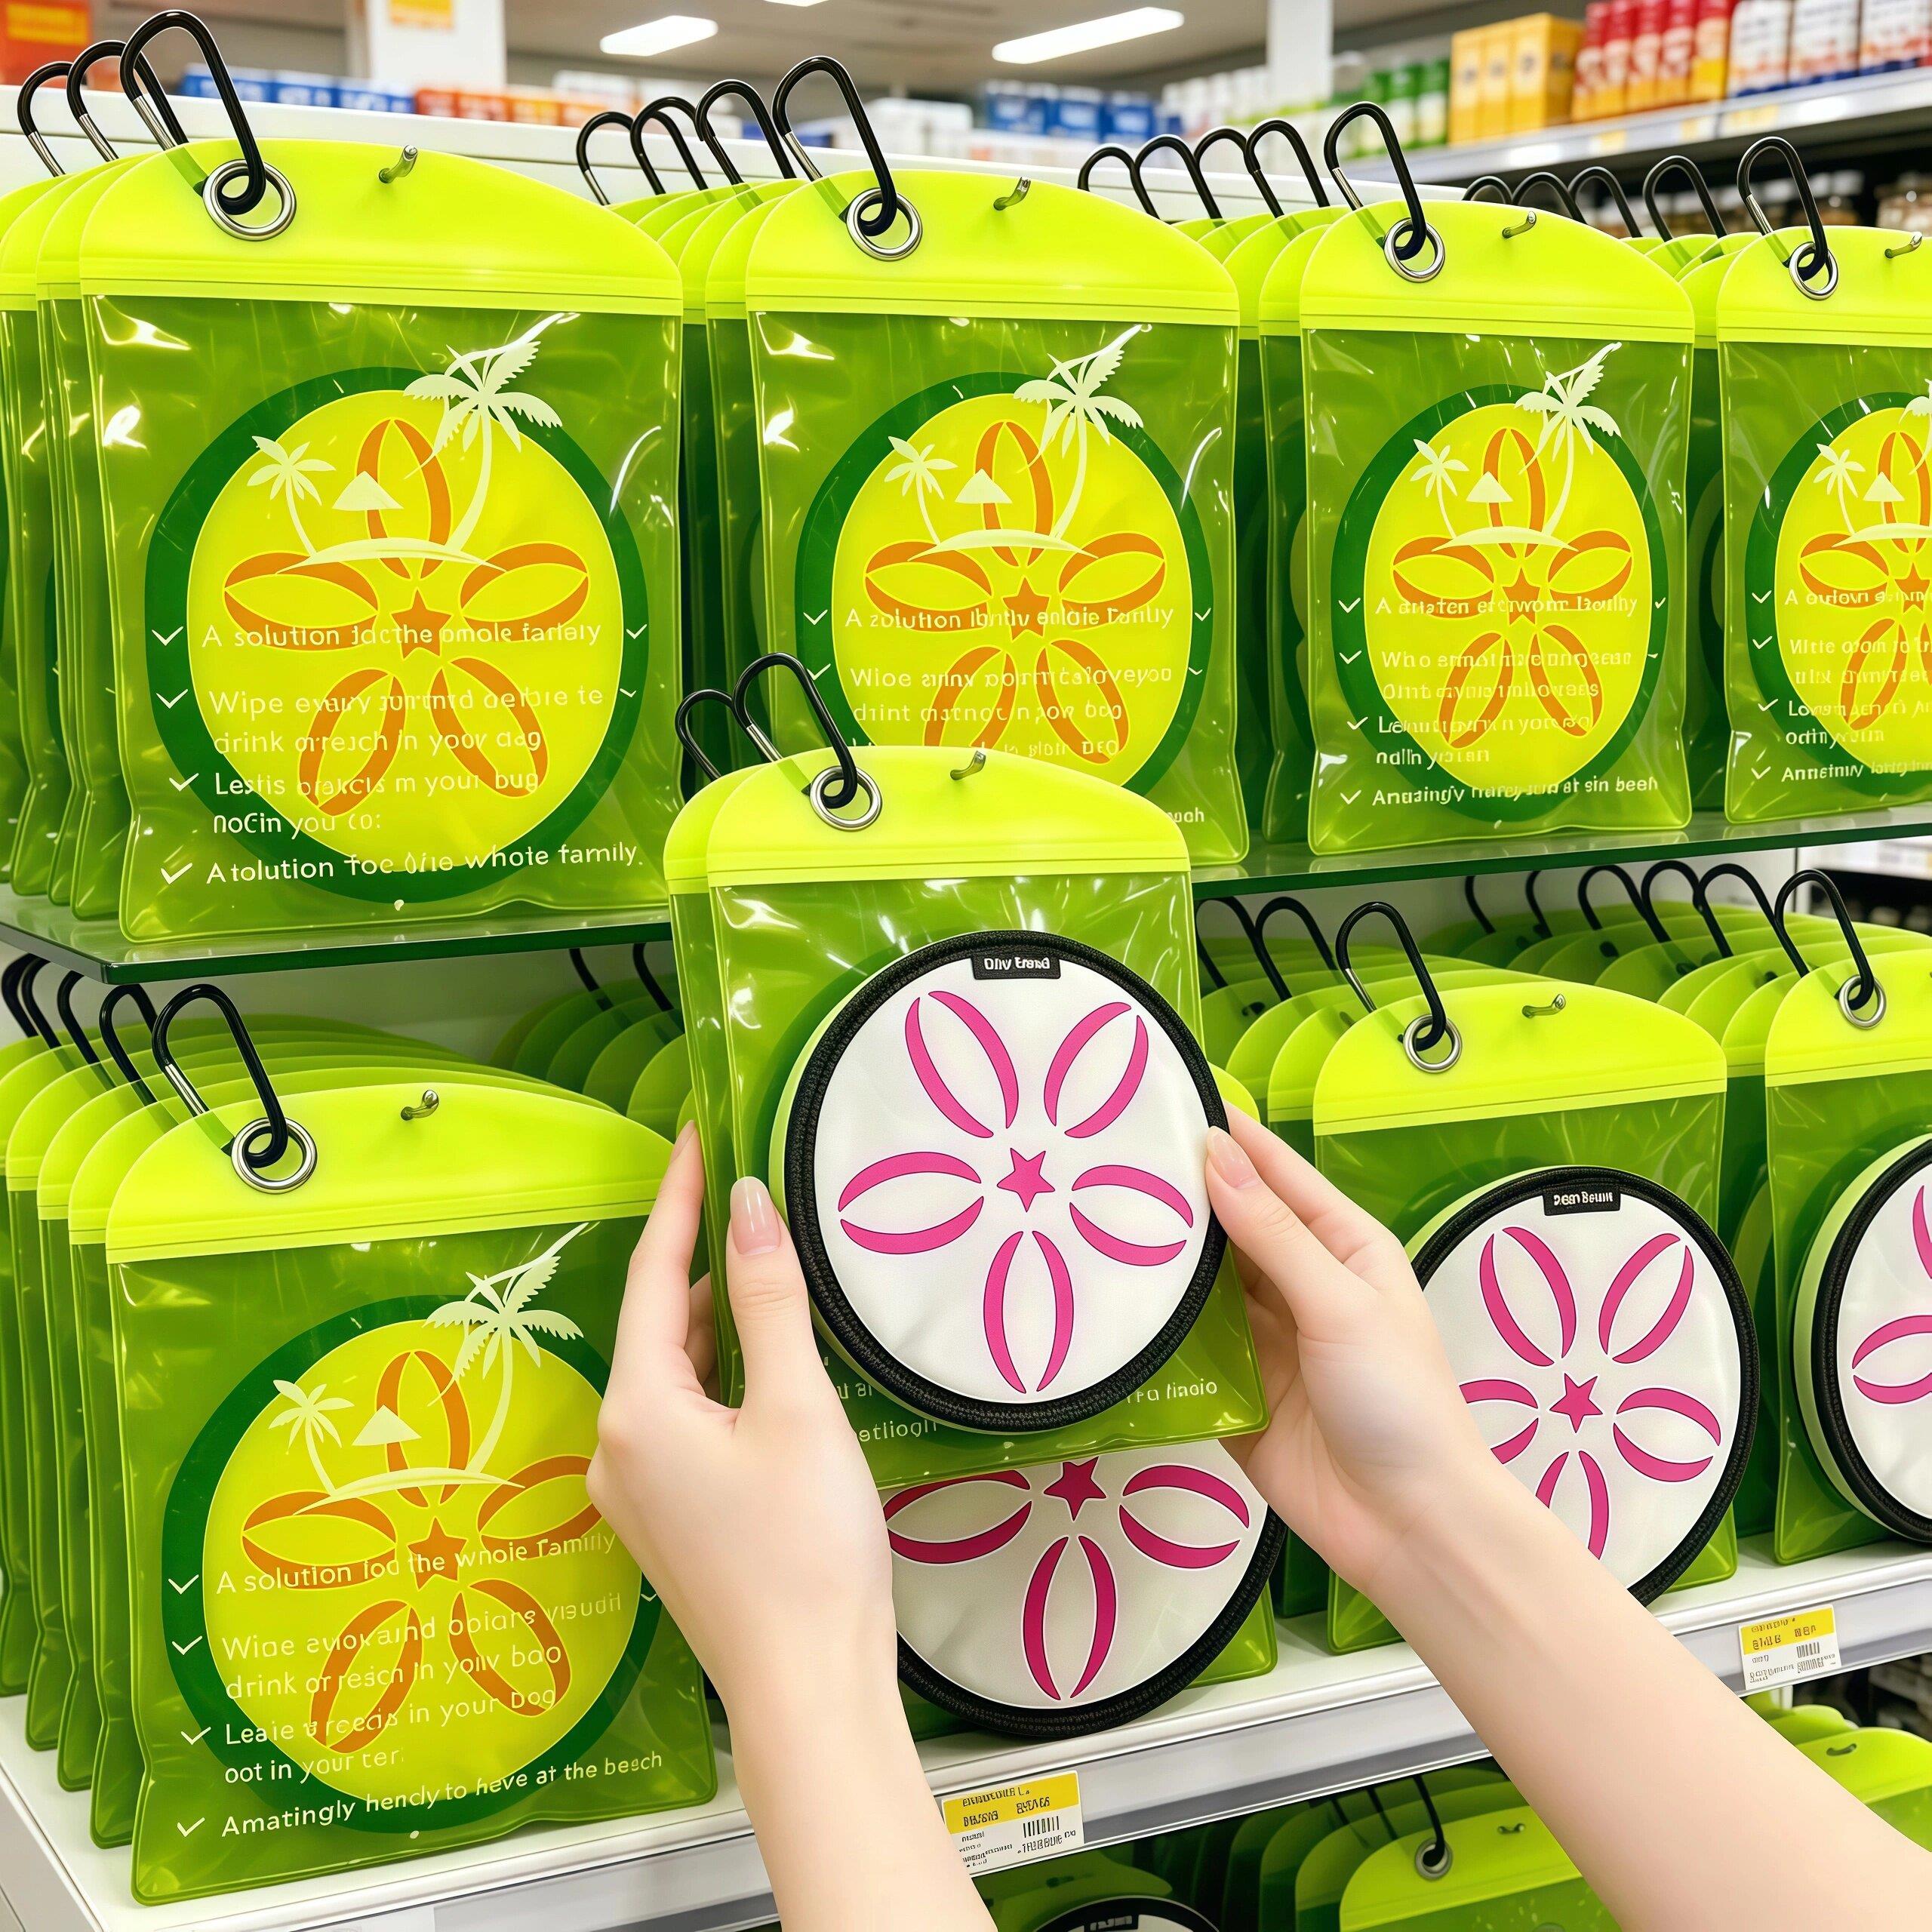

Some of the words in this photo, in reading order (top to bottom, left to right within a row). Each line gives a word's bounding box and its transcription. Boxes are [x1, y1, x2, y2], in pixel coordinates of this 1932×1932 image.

[1374, 596, 1392, 614] A
[1785, 589, 1799, 606] A
[844, 608, 863, 628] A
[202, 625, 222, 648] A
[208, 691, 284, 721] Wipe
[216, 1571, 237, 1595] A
[244, 1566, 352, 1592] solution
[408, 1552, 446, 1574] the
[226, 1671, 297, 1700] drink
[409, 1703, 430, 1724] in
[440, 1696, 500, 1727] your
[270, 1759, 292, 1780] in
[300, 1755, 355, 1784] your
[221, 1799, 356, 1838] Amatingly
[445, 1783, 468, 1801] to
[536, 1765, 557, 1786] at
[564, 1761, 598, 1781] the
